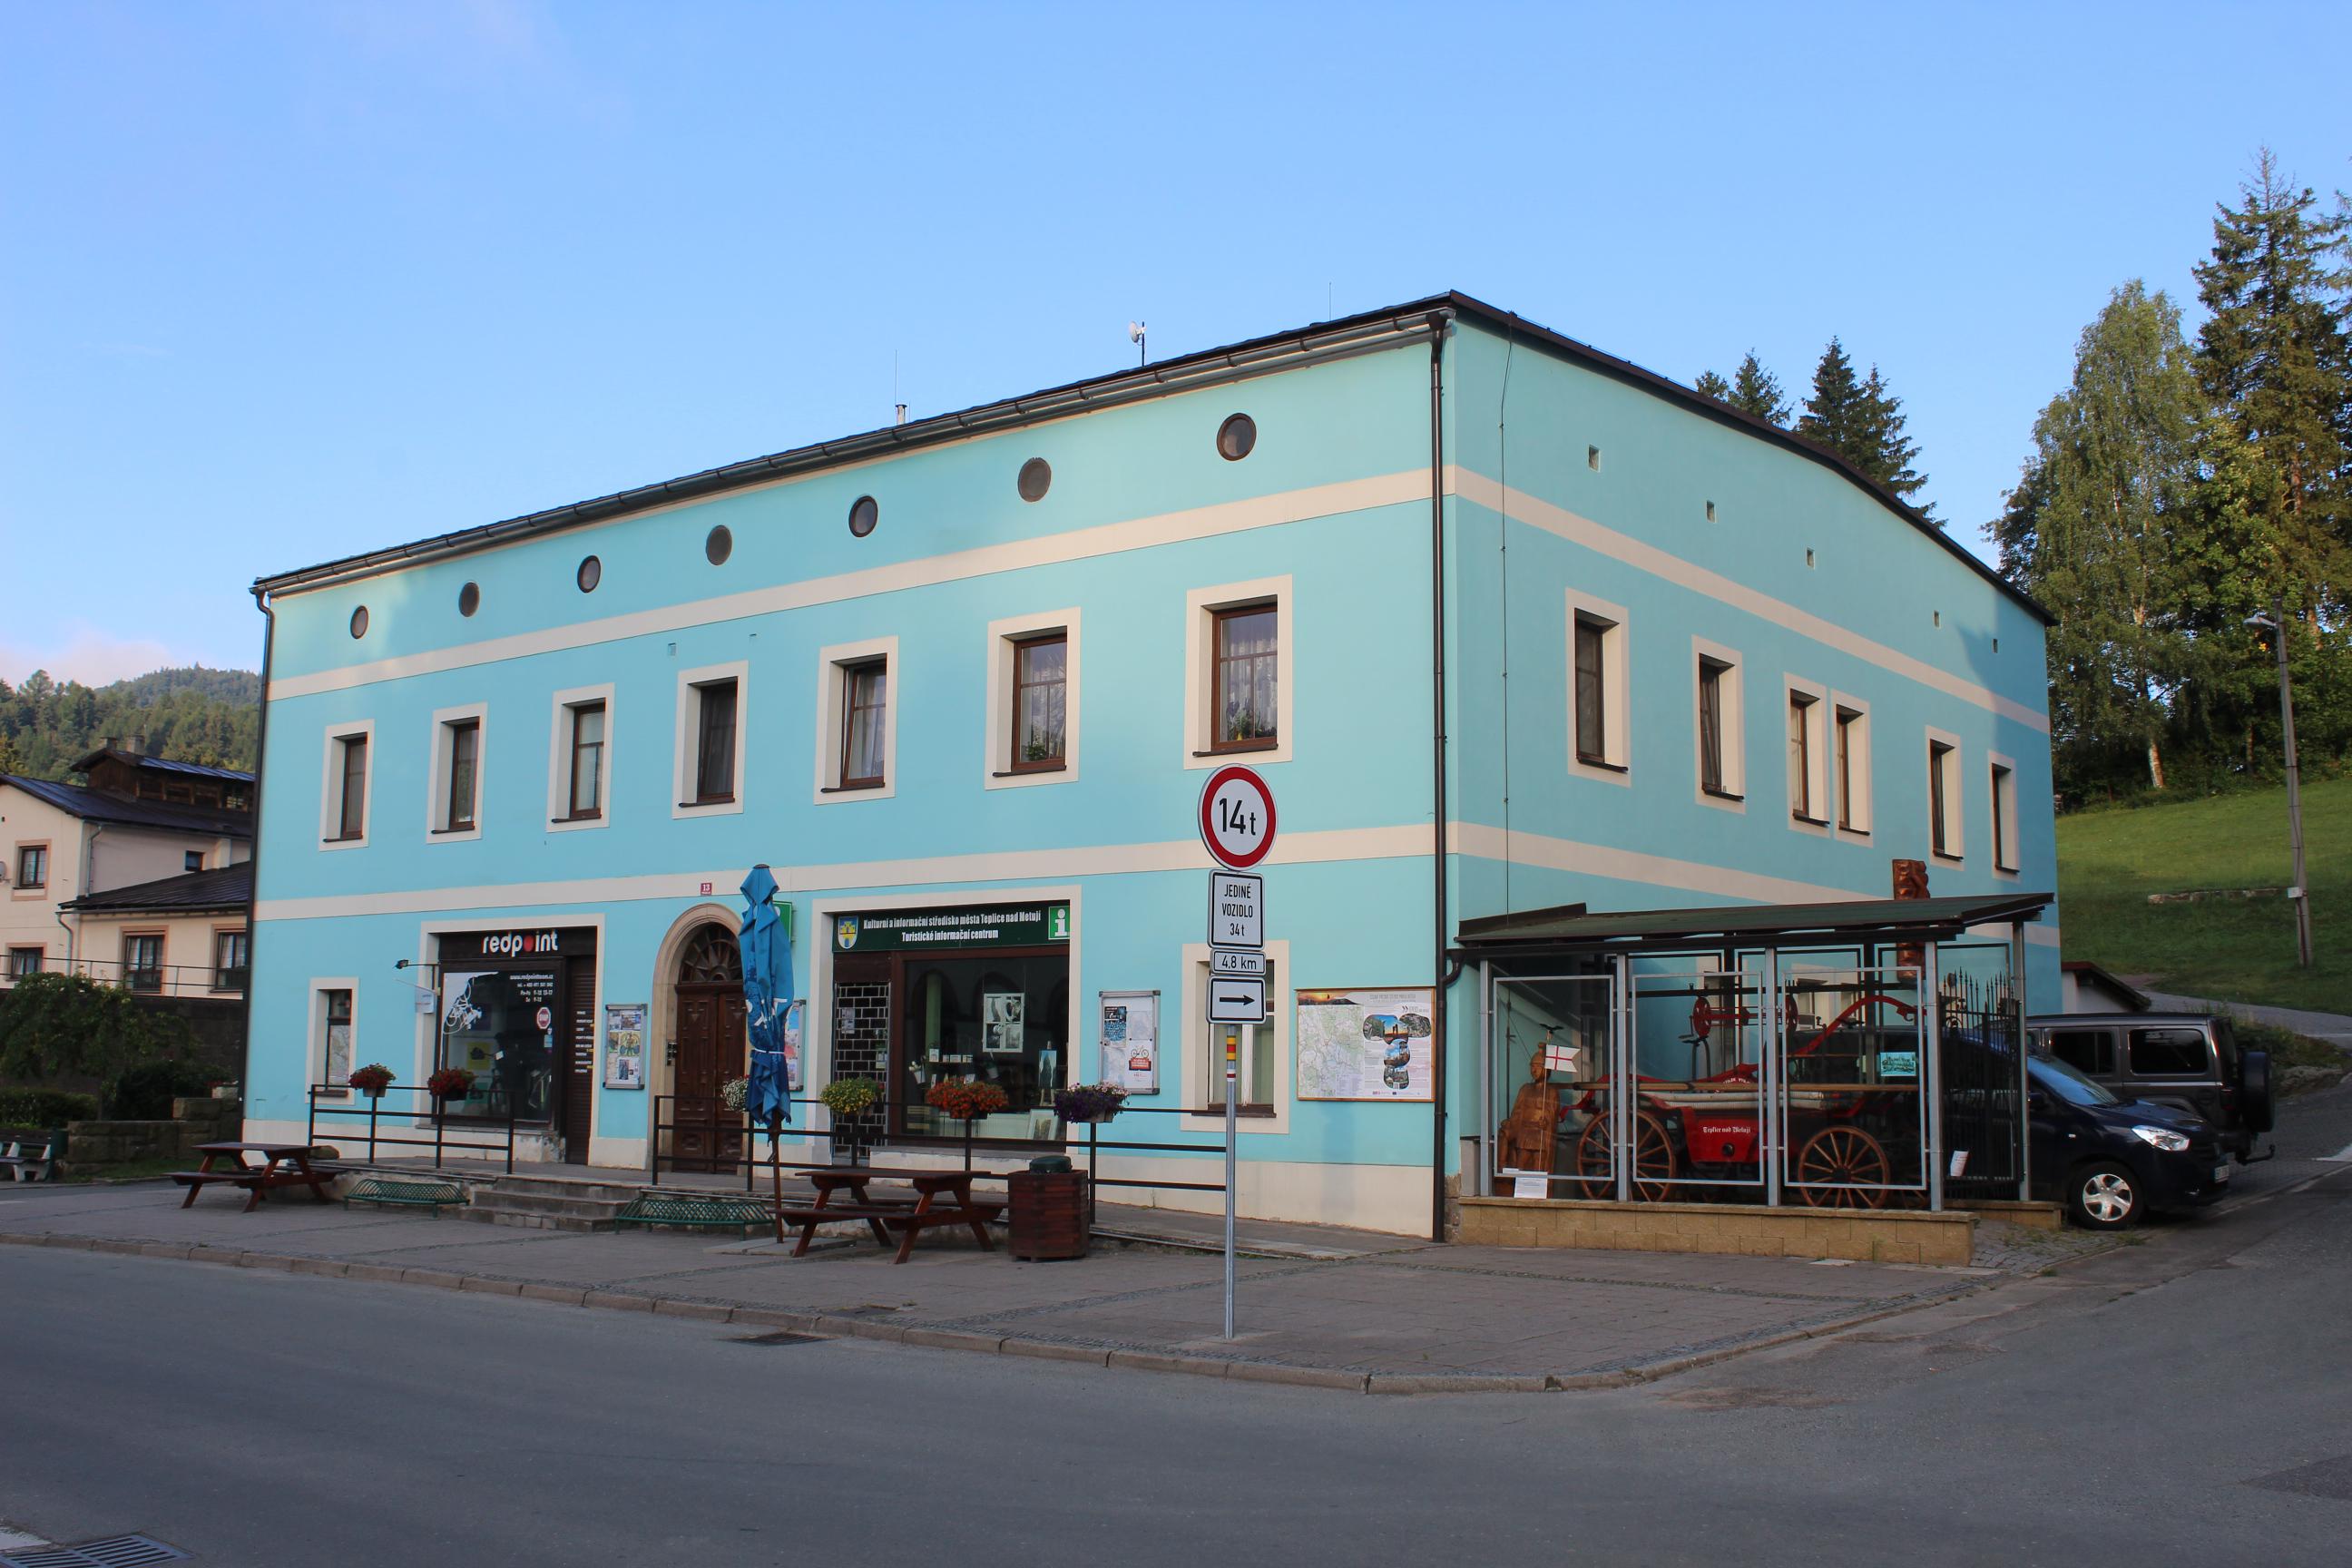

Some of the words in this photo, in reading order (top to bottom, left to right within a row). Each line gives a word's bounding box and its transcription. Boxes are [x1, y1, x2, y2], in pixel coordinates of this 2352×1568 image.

[702, 884, 710, 892] 13
[1224, 883, 1251, 899] JEDINÉ
[1221, 903, 1253, 918] VOZIDLO
[889, 919, 894, 928] a
[928, 915, 959, 926] středisko
[960, 914, 980, 925] města
[980, 913, 1004, 925] Teplice
[1005, 912, 1018, 922] nad
[1019, 910, 1042, 922] Metují
[901, 930, 935, 942] Turistické
[935, 929, 970, 941] informační
[970, 929, 999, 940] centrum
[482, 930, 559, 957] redpoint
[1240, 956, 1257, 970] km
